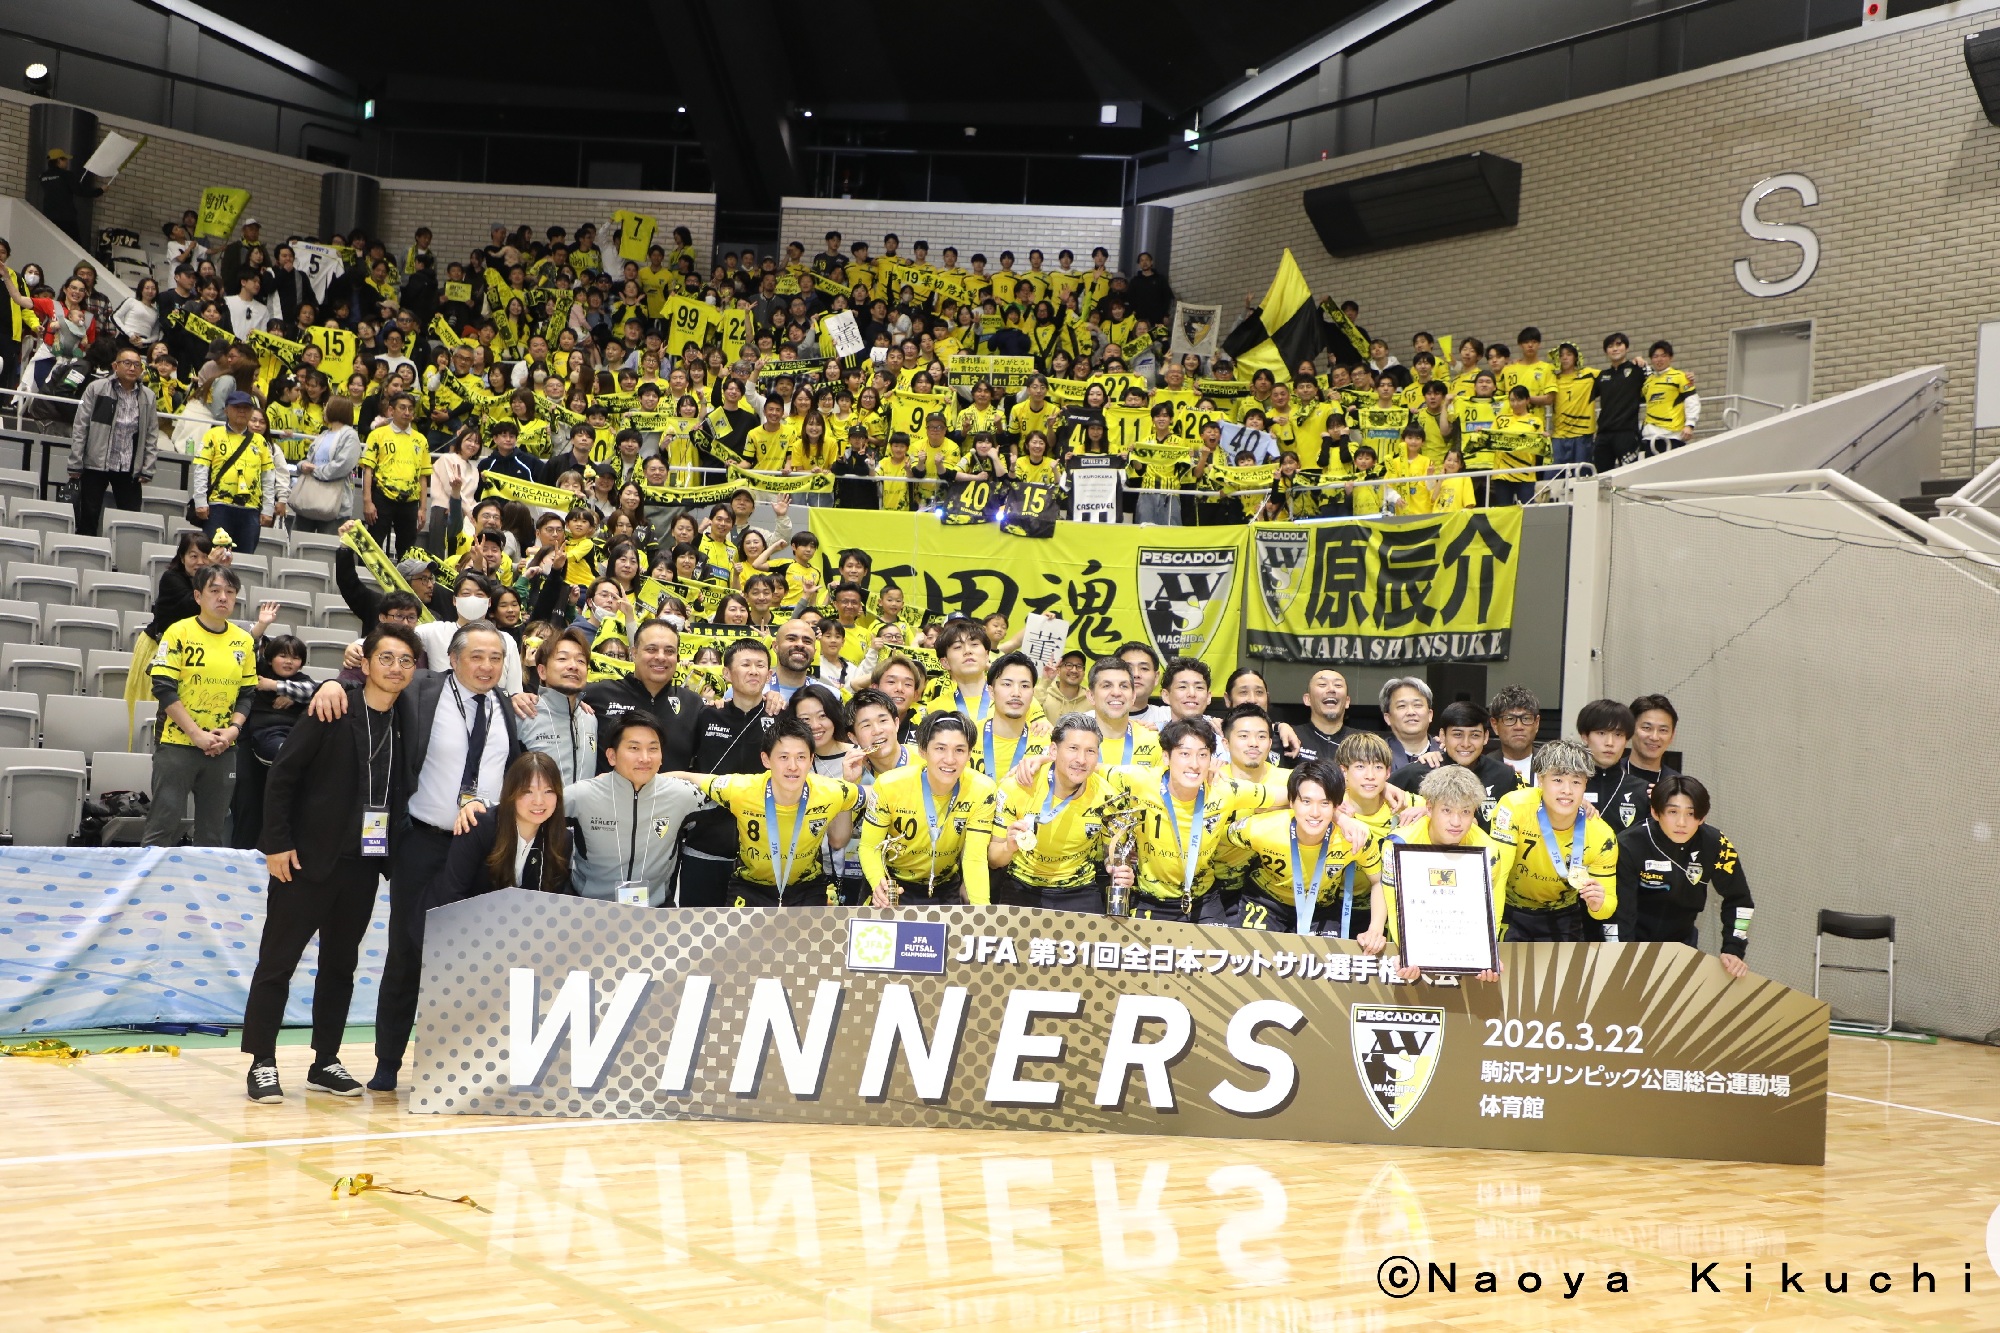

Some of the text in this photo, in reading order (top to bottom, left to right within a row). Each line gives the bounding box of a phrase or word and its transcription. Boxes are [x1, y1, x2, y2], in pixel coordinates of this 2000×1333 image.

[634, 216, 643, 238] 7
[1733, 171, 1820, 297] S
[309, 254, 322, 275] 5
[904, 270, 919, 284] 19
[676, 305, 699, 330] 99
[323, 330, 345, 357] 15
[1105, 376, 1130, 403] 22
[1507, 374, 1518, 386] 20
[909, 406, 924, 433] 9
[1464, 408, 1478, 421] 20
[1500, 418, 1510, 428] 22
[1118, 417, 1140, 446] 11
[1229, 426, 1261, 453] 40
[219, 443, 227, 456] 9
[384, 442, 396, 455] 10
[760, 443, 767, 455] 9
[512, 490, 560, 506] MACHIDA
[960, 480, 990, 510] 40
[1022, 485, 1048, 514] 15
[1256, 531, 1309, 541] PESCADOLA
[1141, 551, 1235, 564] PESCADOLA
[1305, 513, 1513, 632] 原辰介
[1157, 634, 1206, 643] MACHIDA
[1298, 632, 1502, 662] HARA SHINSUKE
[184, 645, 206, 667] 22
[747, 819, 760, 842] 8
[893, 816, 918, 841] 40
[770, 841, 778, 856] JFA
[1190, 835, 1198, 848] JFA
[1521, 838, 1537, 861] 7
[1261, 854, 1287, 878] 22
[1551, 851, 1561, 865] JFA
[1309, 882, 1318, 896] JFA
[1242, 900, 1269, 930] 22
[904, 943, 936, 954] FUTSAL
[912, 935, 929, 945] JFA
[955, 934, 1019, 966] JFA
[900, 951, 938, 960] CHAMPIONSHIP
[1356, 1009, 1441, 1024] PESCADOLA
[509, 966, 1305, 1113] WINNERS
[1482, 1018, 1645, 1055] 2026.3.22
[1373, 1083, 1417, 1094] MACHIDA
[1480, 1059, 1791, 1098] 駒沢オリンピック公園総合運動場
[1479, 1094, 1545, 1120] 体育館
